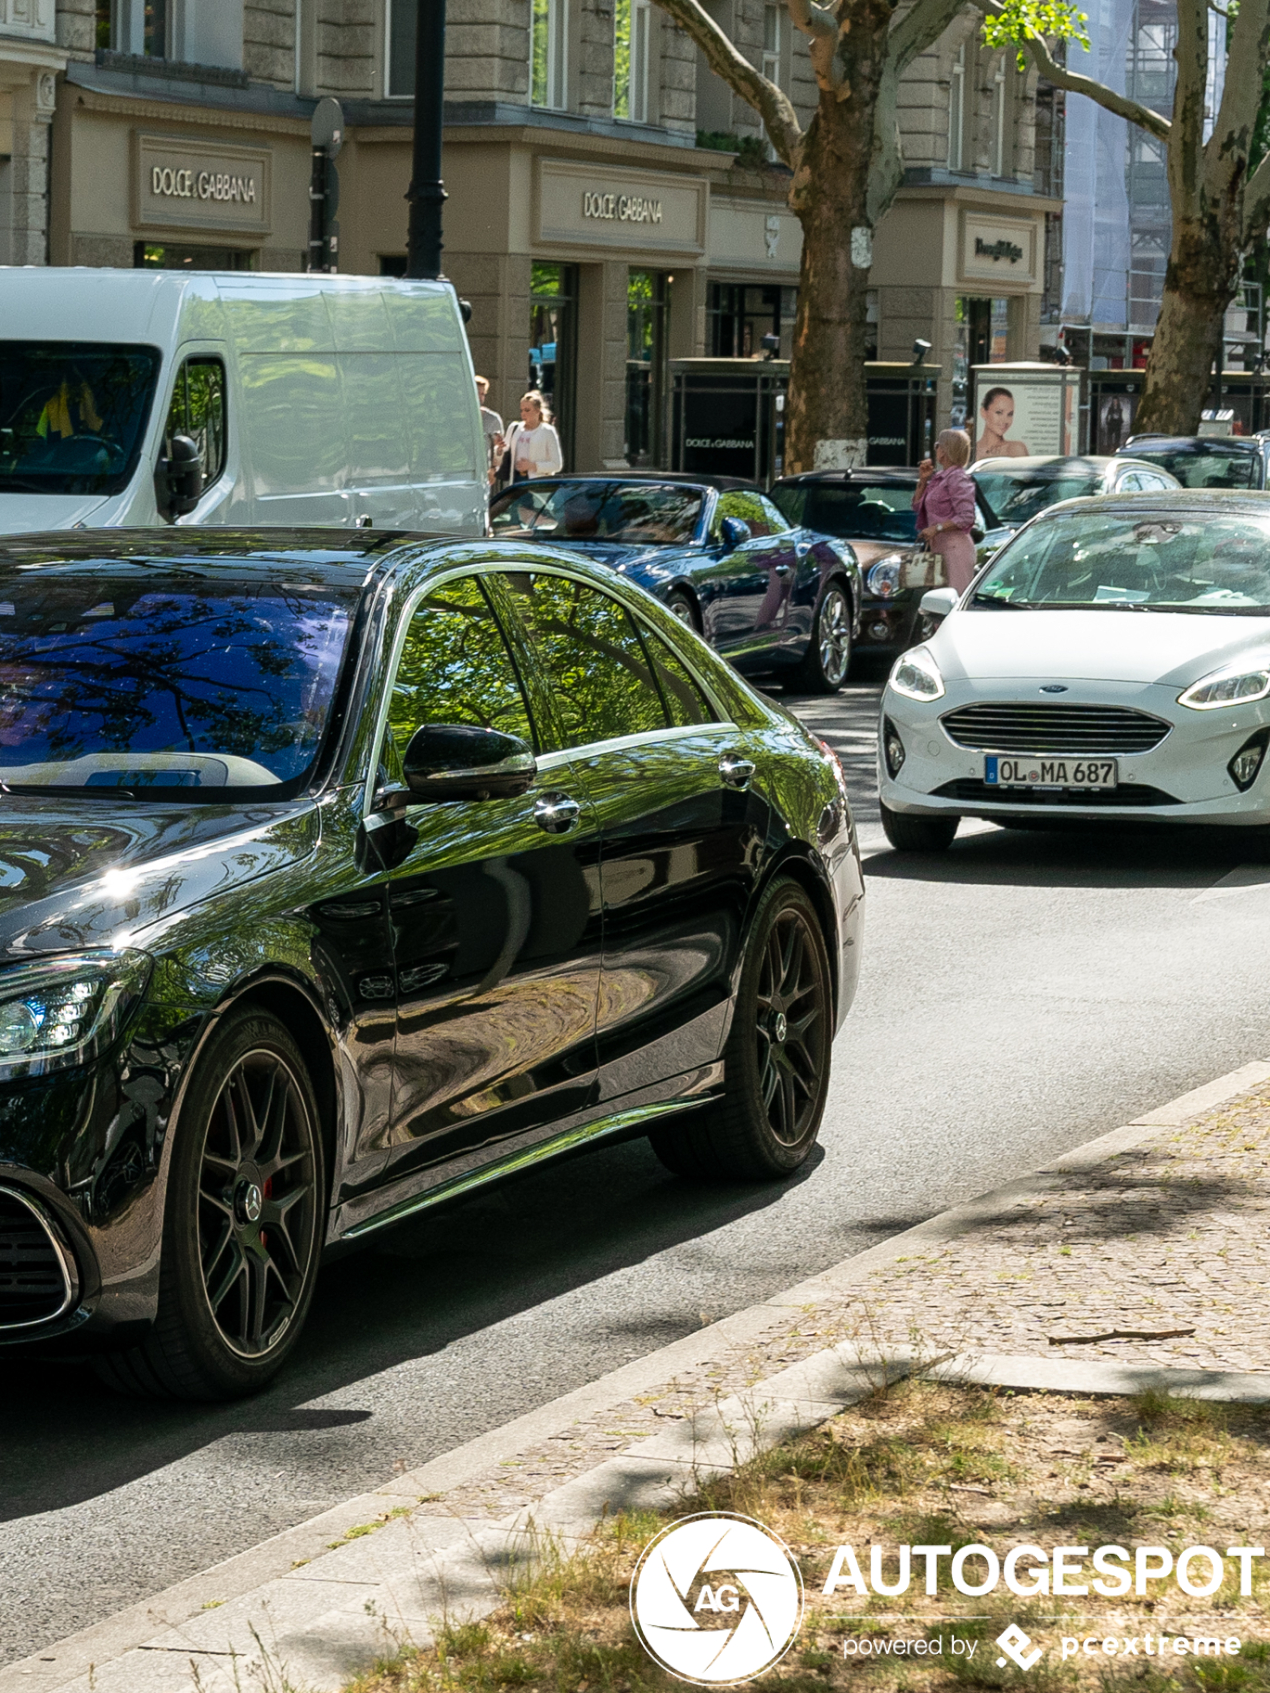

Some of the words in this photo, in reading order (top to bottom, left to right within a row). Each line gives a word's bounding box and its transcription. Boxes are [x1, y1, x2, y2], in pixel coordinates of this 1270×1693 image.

[153, 167, 192, 197] DOLCE
[198, 172, 256, 202] GABBANA
[584, 192, 614, 218] DOLCE
[618, 195, 662, 223] GABBANA
[686, 438, 711, 448] DOLCE
[715, 439, 755, 449] GABBANA
[868, 437, 906, 446] GABBANA
[1000, 761, 1027, 782] OL
[1041, 762, 1069, 783] MA
[1073, 763, 1113, 784] 687
